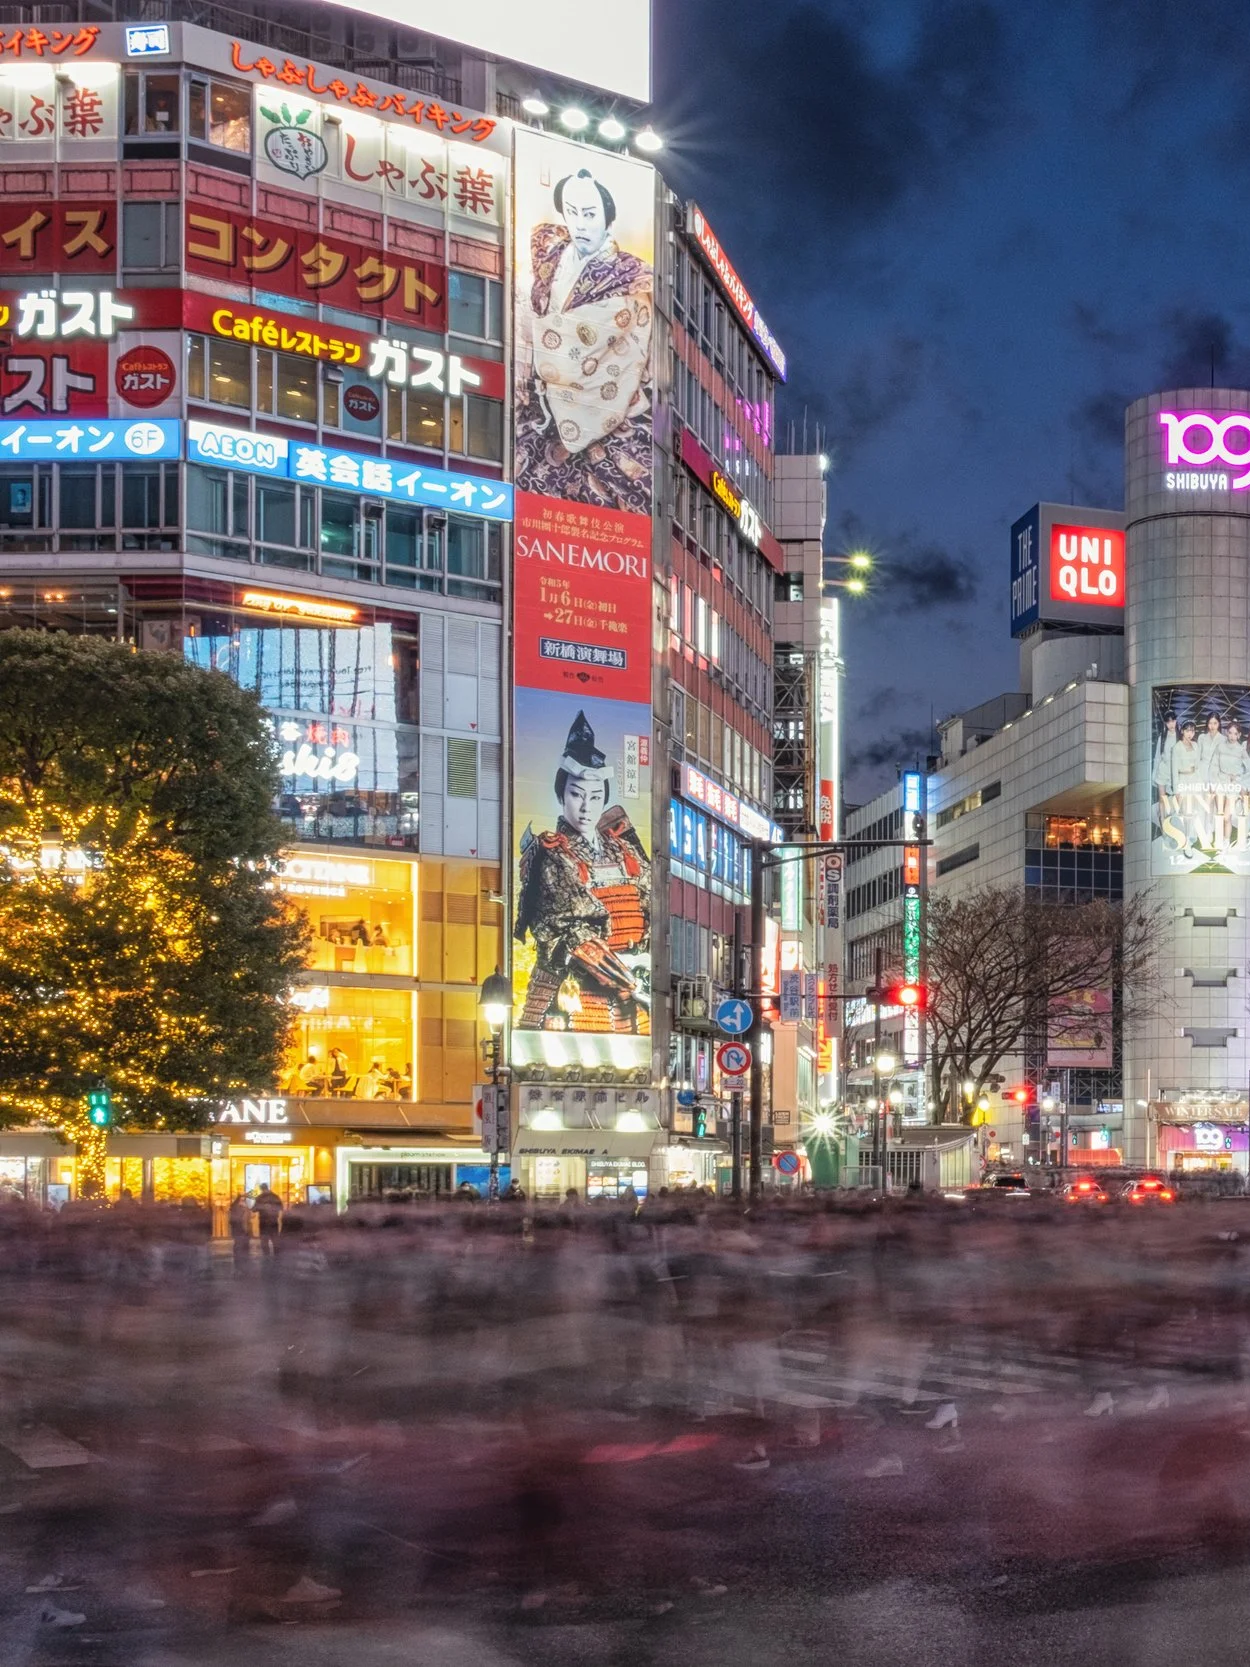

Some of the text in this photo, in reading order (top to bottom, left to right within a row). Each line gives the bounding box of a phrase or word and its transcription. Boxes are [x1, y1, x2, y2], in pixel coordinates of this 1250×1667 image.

[231, 40, 497, 142] しゃぶしゃぶバイキング
[344, 132, 495, 214] しゃぶ葉
[188, 213, 441, 314] コンタクト
[18, 290, 134, 337] ガスト
[212, 309, 481, 397] Caféレストラン ガスト
[122, 373, 170, 391] ガスト
[1, 425, 115, 454] イーオン
[200, 431, 277, 467] AEON
[295, 446, 506, 511] 英会話イーオン
[1166, 472, 1228, 490] SHIBUYA
[517, 534, 648, 579] SANEMORI
[1017, 524, 1033, 573] THE
[1058, 533, 1113, 566] UNI
[1012, 564, 1037, 618] PRIME
[1058, 565, 1118, 597] QLO
[1177, 782, 1242, 793] SHIBUYA109
[788, 973, 800, 1018] 渋谷駅前
[1165, 1106, 1243, 1117] WINTER SALE
